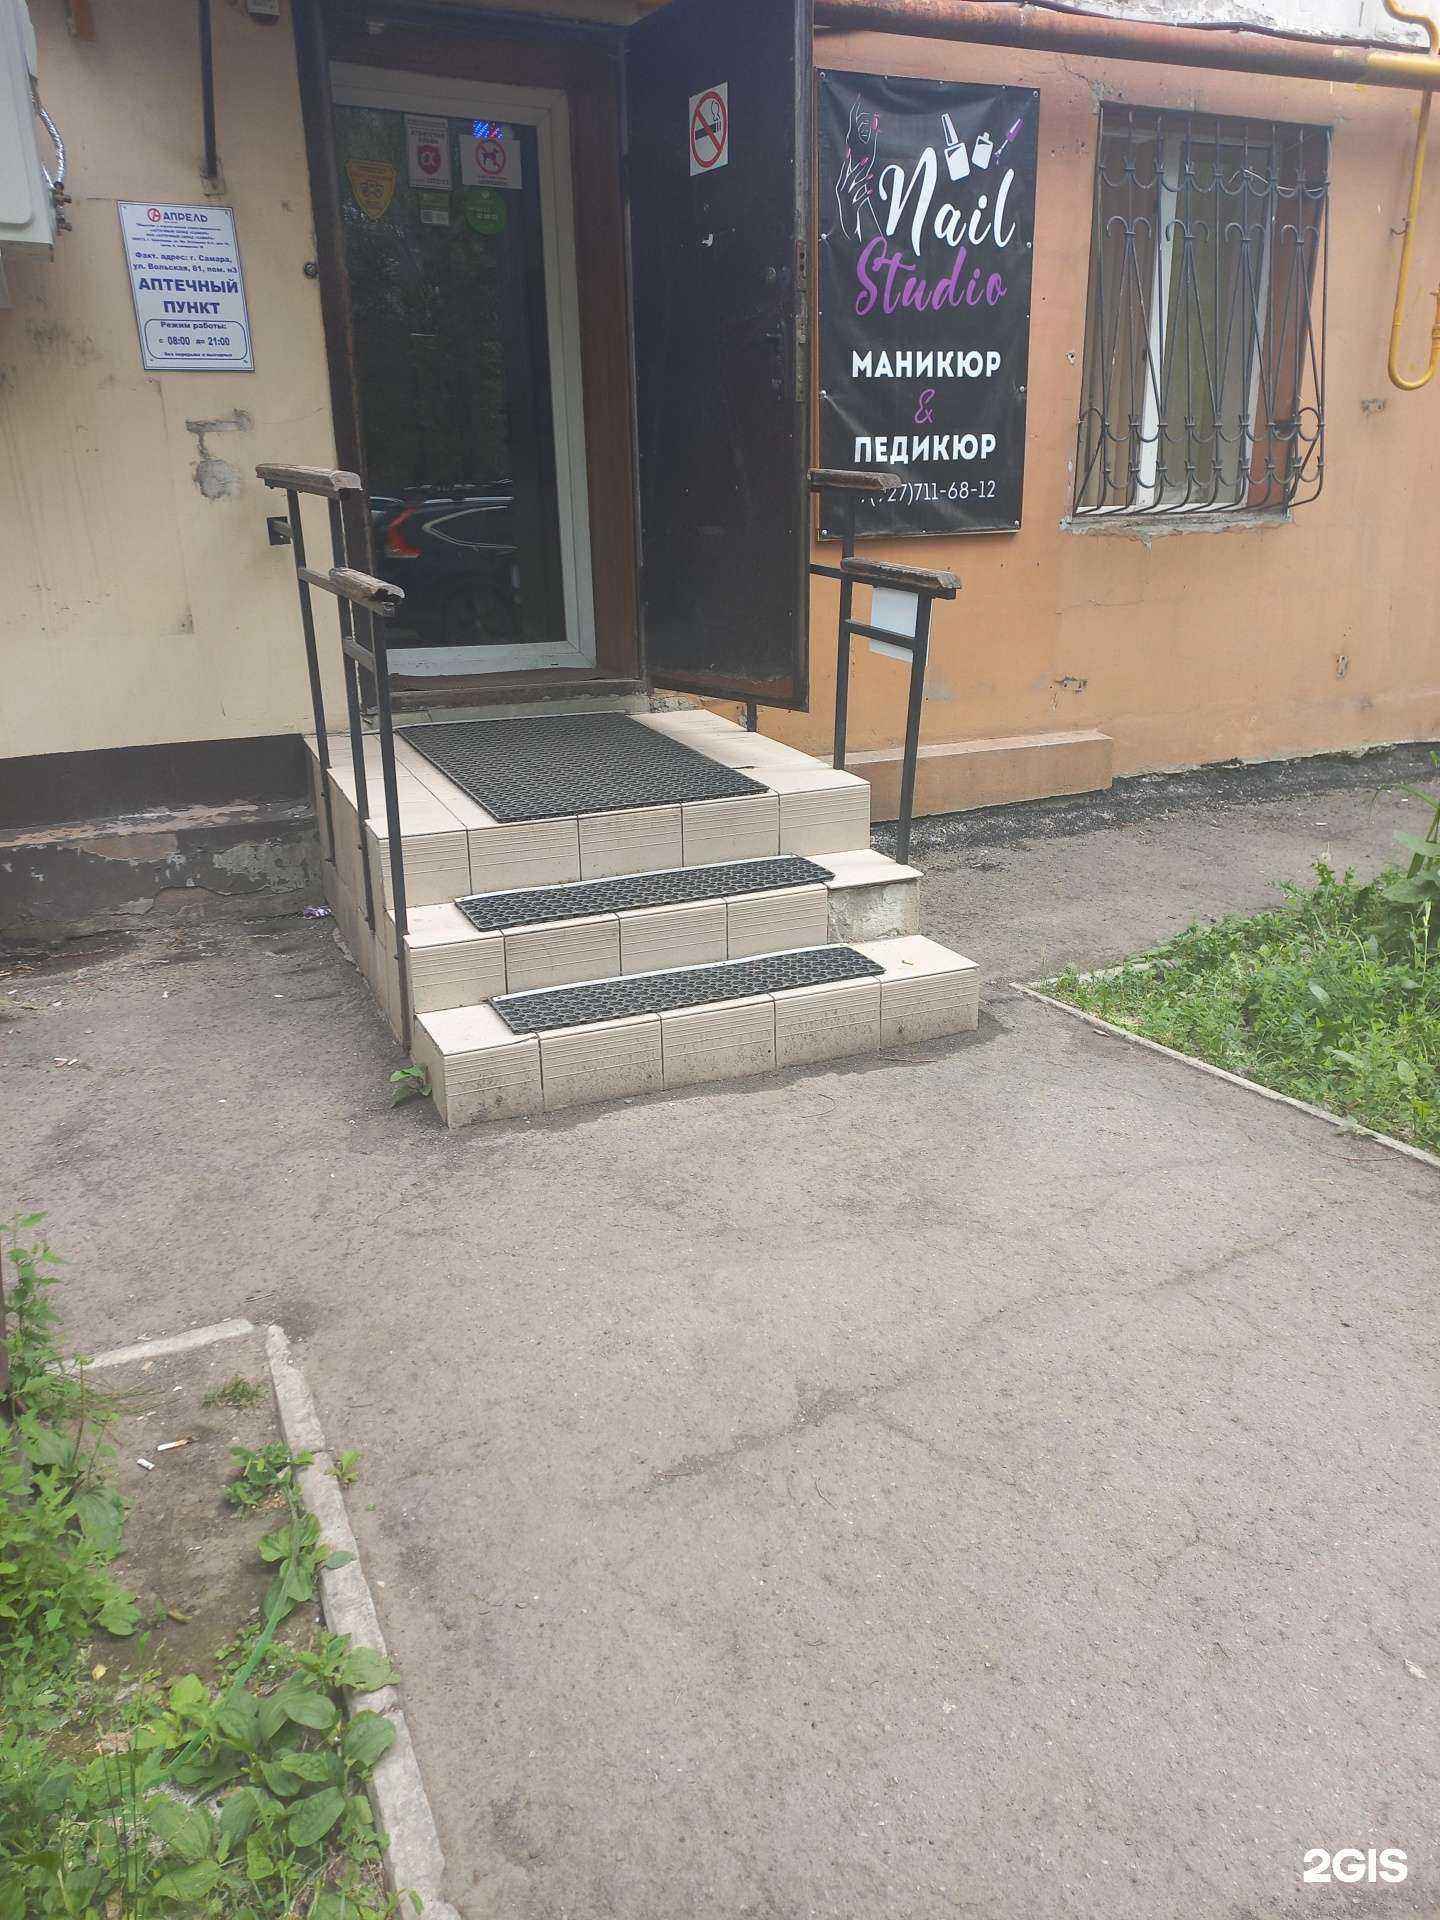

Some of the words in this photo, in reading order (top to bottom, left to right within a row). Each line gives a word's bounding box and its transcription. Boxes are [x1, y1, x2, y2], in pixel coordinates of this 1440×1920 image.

[879, 147, 1016, 256] Nail
[138, 277, 239, 294] АПТЕЧНЫЙ
[856, 236, 1007, 315] Studio
[163, 300, 220, 315] ПУНКТ
[160, 321, 191, 329] Режим
[167, 336, 191, 346] 08:00
[207, 336, 231, 346] 21:00
[851, 350, 1001, 378] МАНИКЮР
[913, 388, 936, 425] &
[854, 433, 997, 465] ПЕДИКЮР
